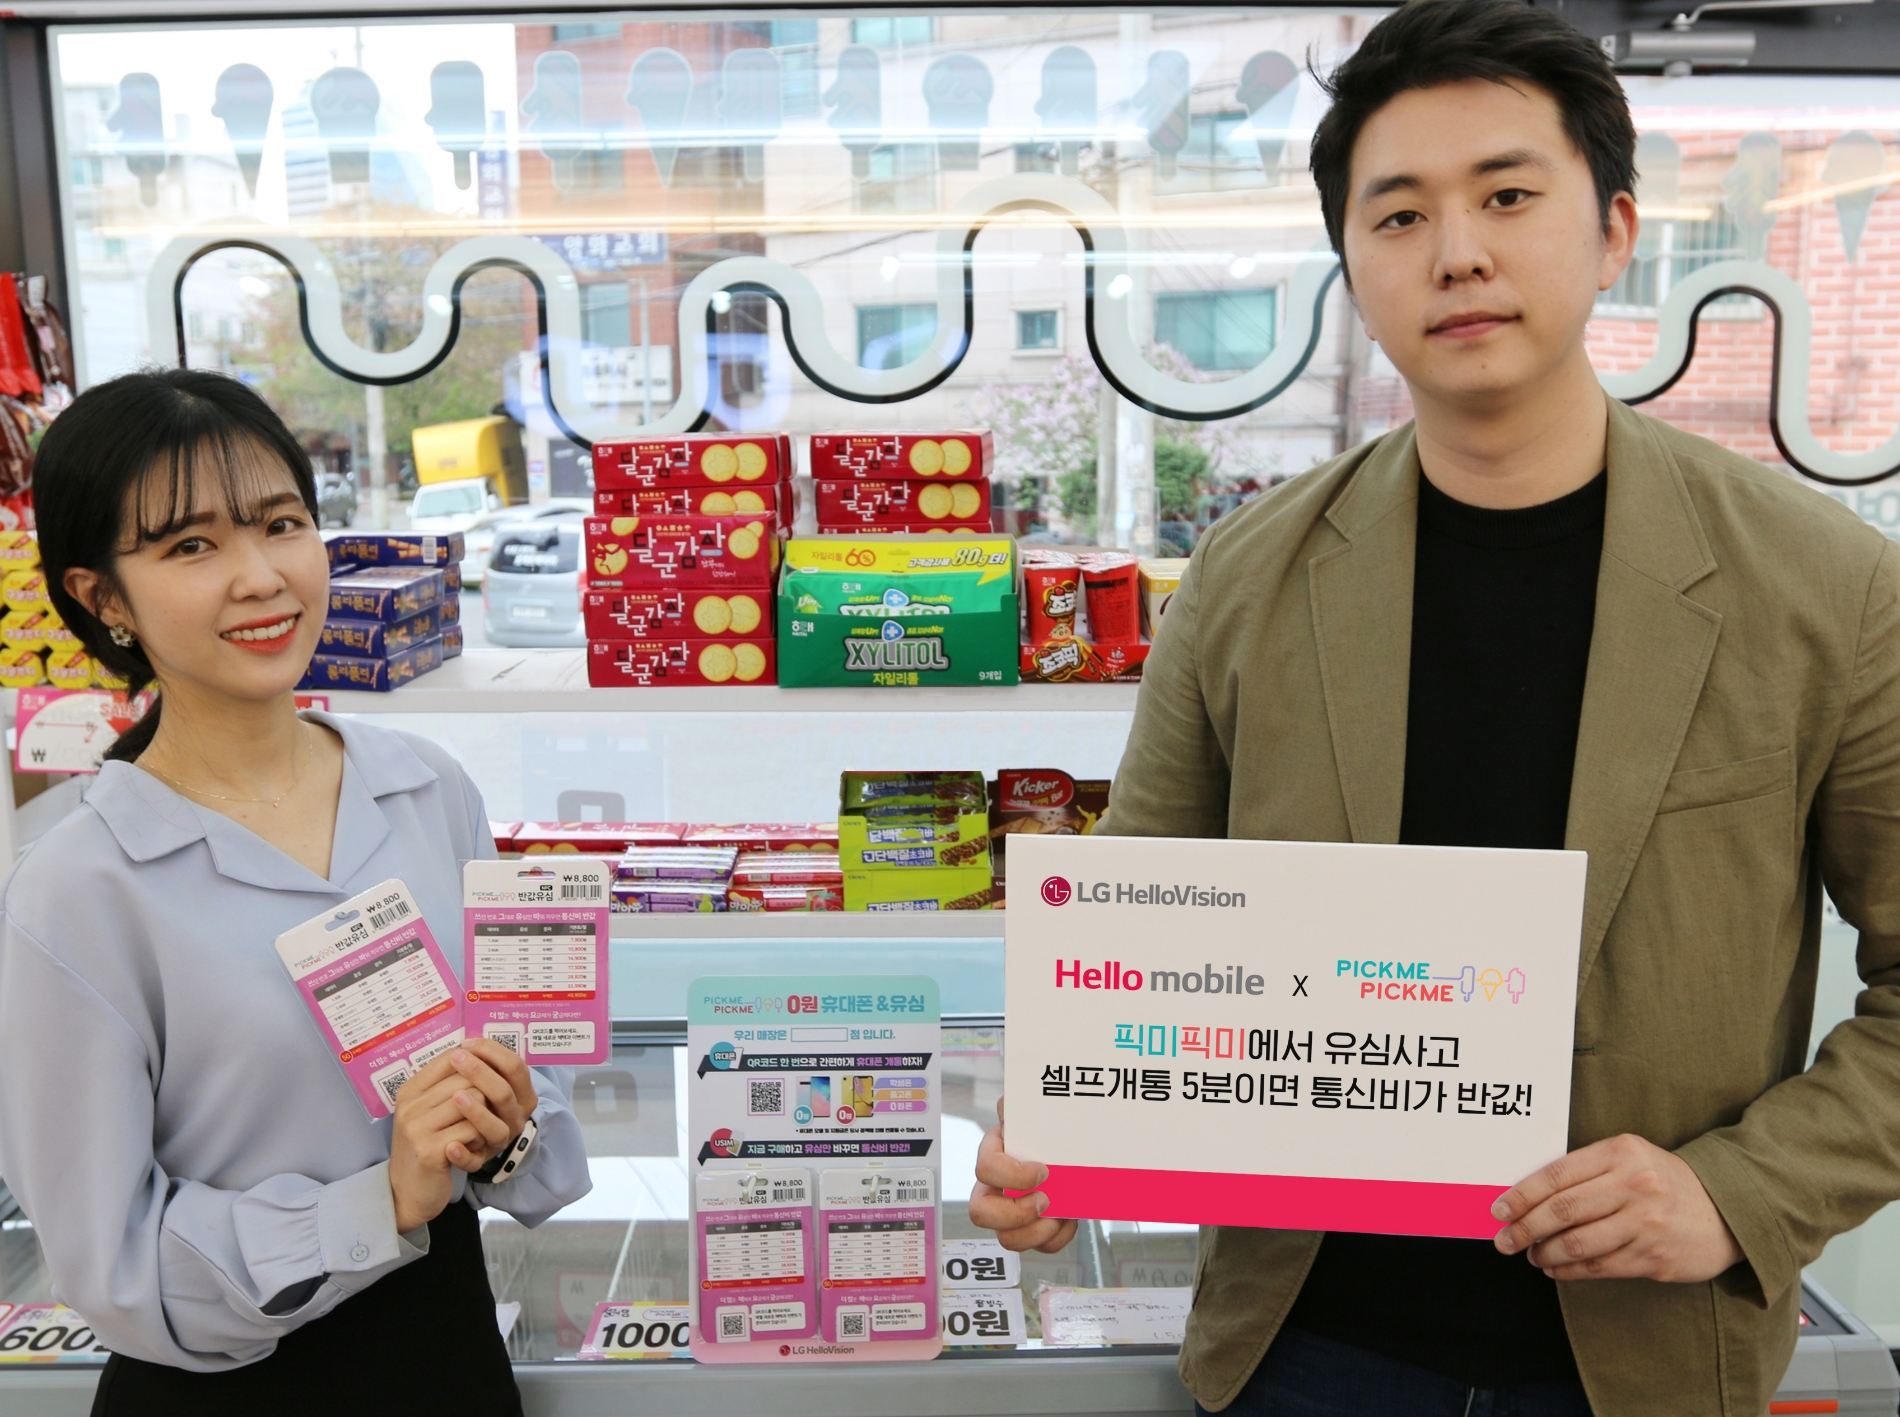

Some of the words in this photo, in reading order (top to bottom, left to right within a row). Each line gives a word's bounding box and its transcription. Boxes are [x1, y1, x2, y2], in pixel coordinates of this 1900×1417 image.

[617, 442, 692, 487] 달군감자
[833, 436, 902, 477] 달군감자
[840, 481, 911, 521] 달군감자
[629, 522, 726, 578] 달군감자
[811, 551, 843, 561] 자일리톨
[845, 548, 876, 567] 60%
[988, 551, 1008, 565] 더!
[609, 592, 685, 637] 달군감자
[613, 641, 690, 685] 달군감자
[850, 641, 945, 667] XYLITOL
[873, 672, 919, 685] 자일리톨
[979, 670, 1003, 681] 9개입
[1012, 777, 1059, 797] Kicker
[1050, 790, 1063, 803] Bar
[863, 849, 935, 863] 고단백질초코바
[563, 874, 599, 883] ₩8,800
[365, 892, 400, 914] ₩8,800
[518, 892, 554, 902] 반값유심
[1077, 881, 1111, 903] LG
[1116, 882, 1246, 908] HelloVision
[561, 913, 581, 921] 통신비
[582, 913, 596, 921] 반값
[334, 928, 369, 952] 반값유심
[1055, 959, 1143, 991] Hello
[1150, 963, 1265, 996] mobile
[1336, 959, 1431, 981] PICKME
[703, 996, 743, 1005] PICKME
[1360, 982, 1454, 1003] PICKME
[714, 1005, 754, 1014] PICKME
[787, 994, 819, 1014] 0원
[821, 995, 873, 1013] 휴대폰
[734, 1030, 754, 1041] 우리
[757, 1030, 788, 1041] 매장은
[850, 1029, 860, 1040] 점
[863, 1029, 896, 1040] 입니다.
[1114, 1023, 1313, 1063] 픽미픽미에서
[1324, 1032, 1460, 1068] 유심사고
[714, 1052, 737, 1061] 휴대폰
[747, 1058, 778, 1068] QR코드
[780, 1058, 790, 1067] 한
[791, 1057, 818, 1067] 번으로
[819, 1057, 855, 1067] 간편하게
[856, 1057, 884, 1067] 휴대폰
[1041, 1064, 1172, 1101] 셀프개통
[1182, 1071, 1299, 1107] 5분이면
[1310, 1076, 1448, 1113] 통신비가
[1457, 1082, 1532, 1116] 반값!
[714, 1139, 734, 1147] USIM
[747, 1145, 765, 1154] 지금
[767, 1144, 803, 1154] 구매하고
[804, 1144, 831, 1154] 유심만
[833, 1144, 860, 1153] 바꾸면
[861, 1144, 888, 1153] 통신비
[889, 1143, 911, 1153] 반값!
[942, 1257, 1006, 1281] 0원
[942, 1310, 1010, 1337] 0원
[0, 1326, 112, 1353] 600
[602, 1322, 689, 1348] 1000
[792, 1346, 805, 1355] LG
[806, 1346, 855, 1355] HelloVision
